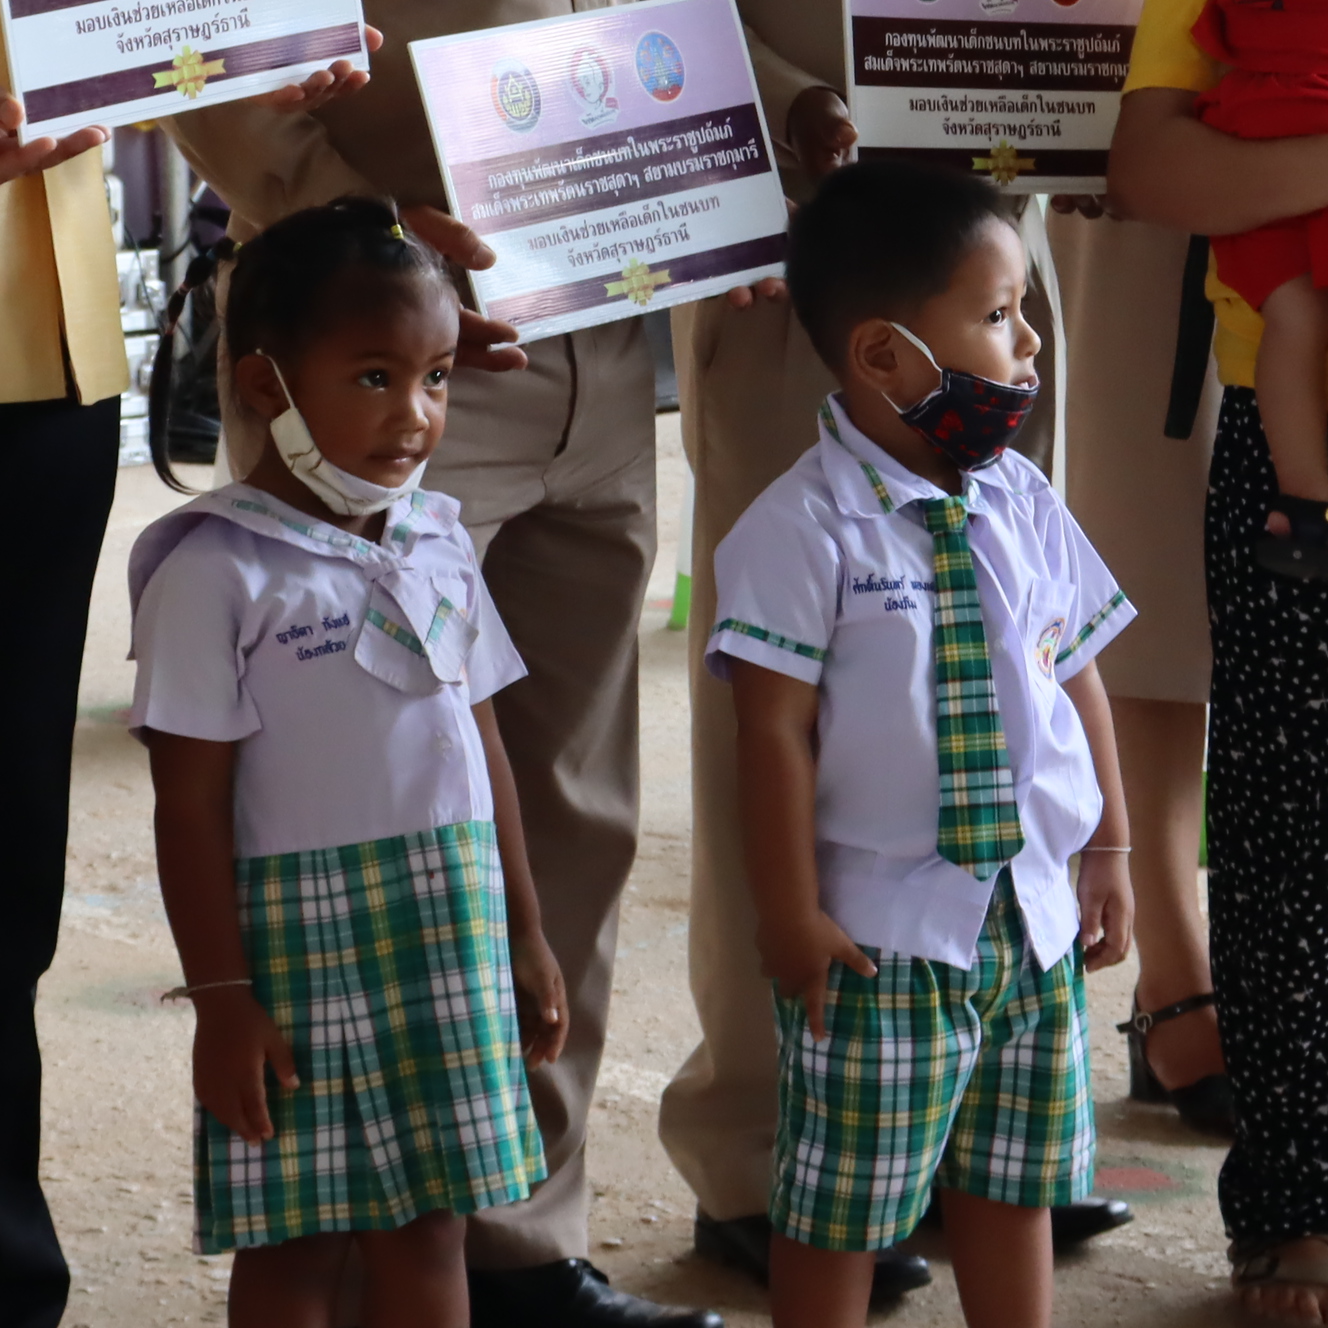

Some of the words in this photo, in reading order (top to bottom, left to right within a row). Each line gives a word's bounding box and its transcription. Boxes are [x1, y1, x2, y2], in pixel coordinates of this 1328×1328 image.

[116, 9, 251, 55] จังหวัดสุราษฎร์ธานี
[885, 28, 1121, 59] กองทุนพัฒนาเด็กชนบทในพระราชูปถัมภ์
[864, 49, 1024, 81] สมเด็จพระเทพรัตนราชสุดาฯ
[909, 94, 1096, 115] มอบเงินช่วยเหลือเด็กในชนบท
[942, 118, 1061, 142] จังหวัดสุราษฎร์ธานี
[488, 117, 733, 190] กองทุนพัฒนาเด็กชนบทในพระราชูปถัมภ์
[471, 173, 640, 220] สมเด็จพระเทพรัตนราชสุดาฯ
[643, 138, 759, 183] สยามบรมราชกุมารี
[528, 195, 721, 251] มอบเงินช่วยเหลือเด็กในชนบท
[568, 222, 691, 268] จังหวัดสุราษฎร์ธานี
